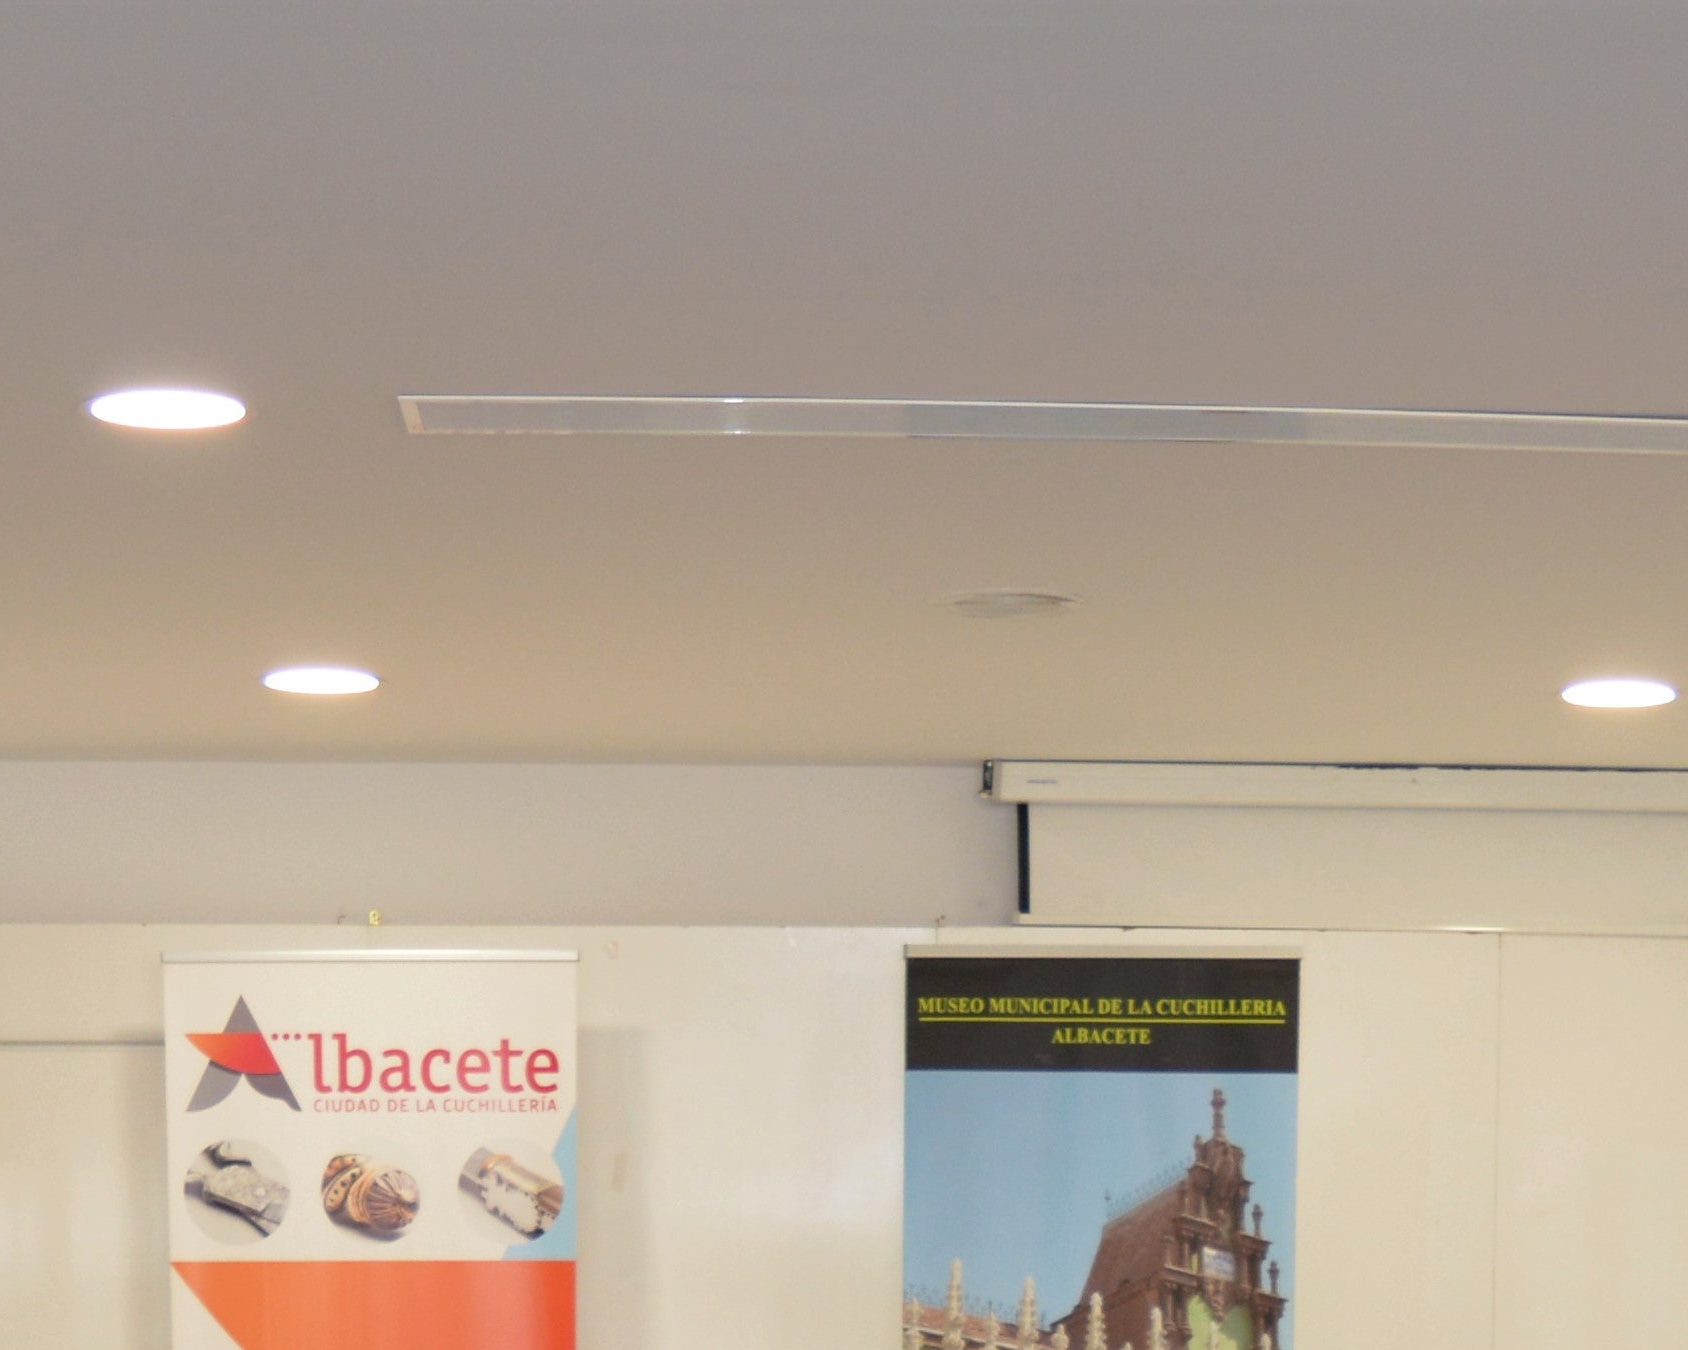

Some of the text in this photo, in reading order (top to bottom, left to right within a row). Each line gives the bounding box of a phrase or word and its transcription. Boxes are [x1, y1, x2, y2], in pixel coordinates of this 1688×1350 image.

[918, 997, 1286, 1016] MUSEO MUNICIPAL DE LA CUCHILLERIA
[1051, 1027, 1151, 1045] ALBACETE
[313, 1097, 558, 1113] CIUDAD DE LA CUCHILLERÍA
